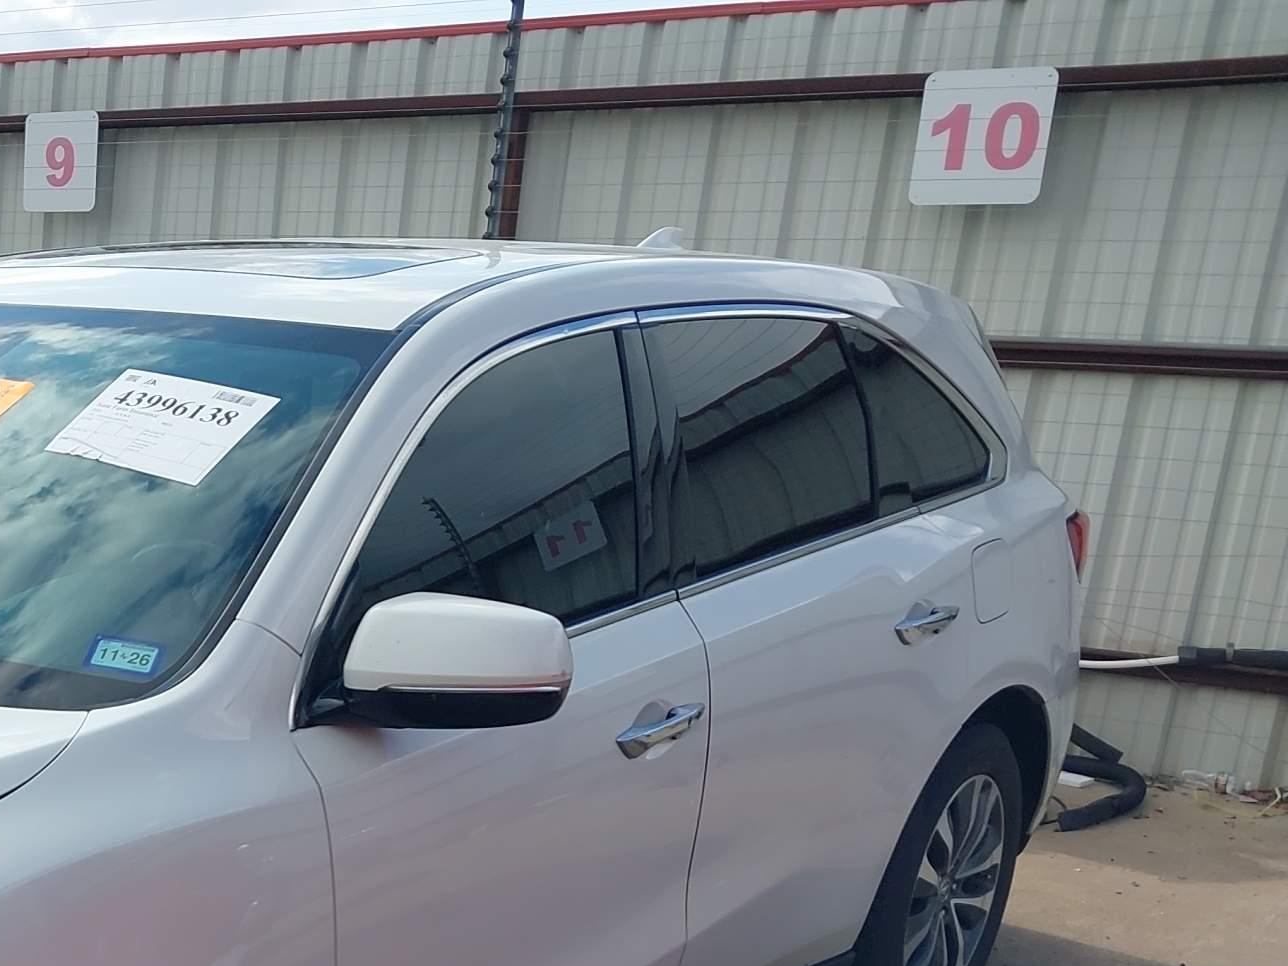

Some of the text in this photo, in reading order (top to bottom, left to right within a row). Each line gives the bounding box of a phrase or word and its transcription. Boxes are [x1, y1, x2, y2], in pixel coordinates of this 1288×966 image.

[931, 102, 1040, 171] 10
[45, 136, 75, 188] 9
[113, 389, 240, 427] 43996138
[100, 647, 119, 661] 11
[127, 652, 152, 666] 26
